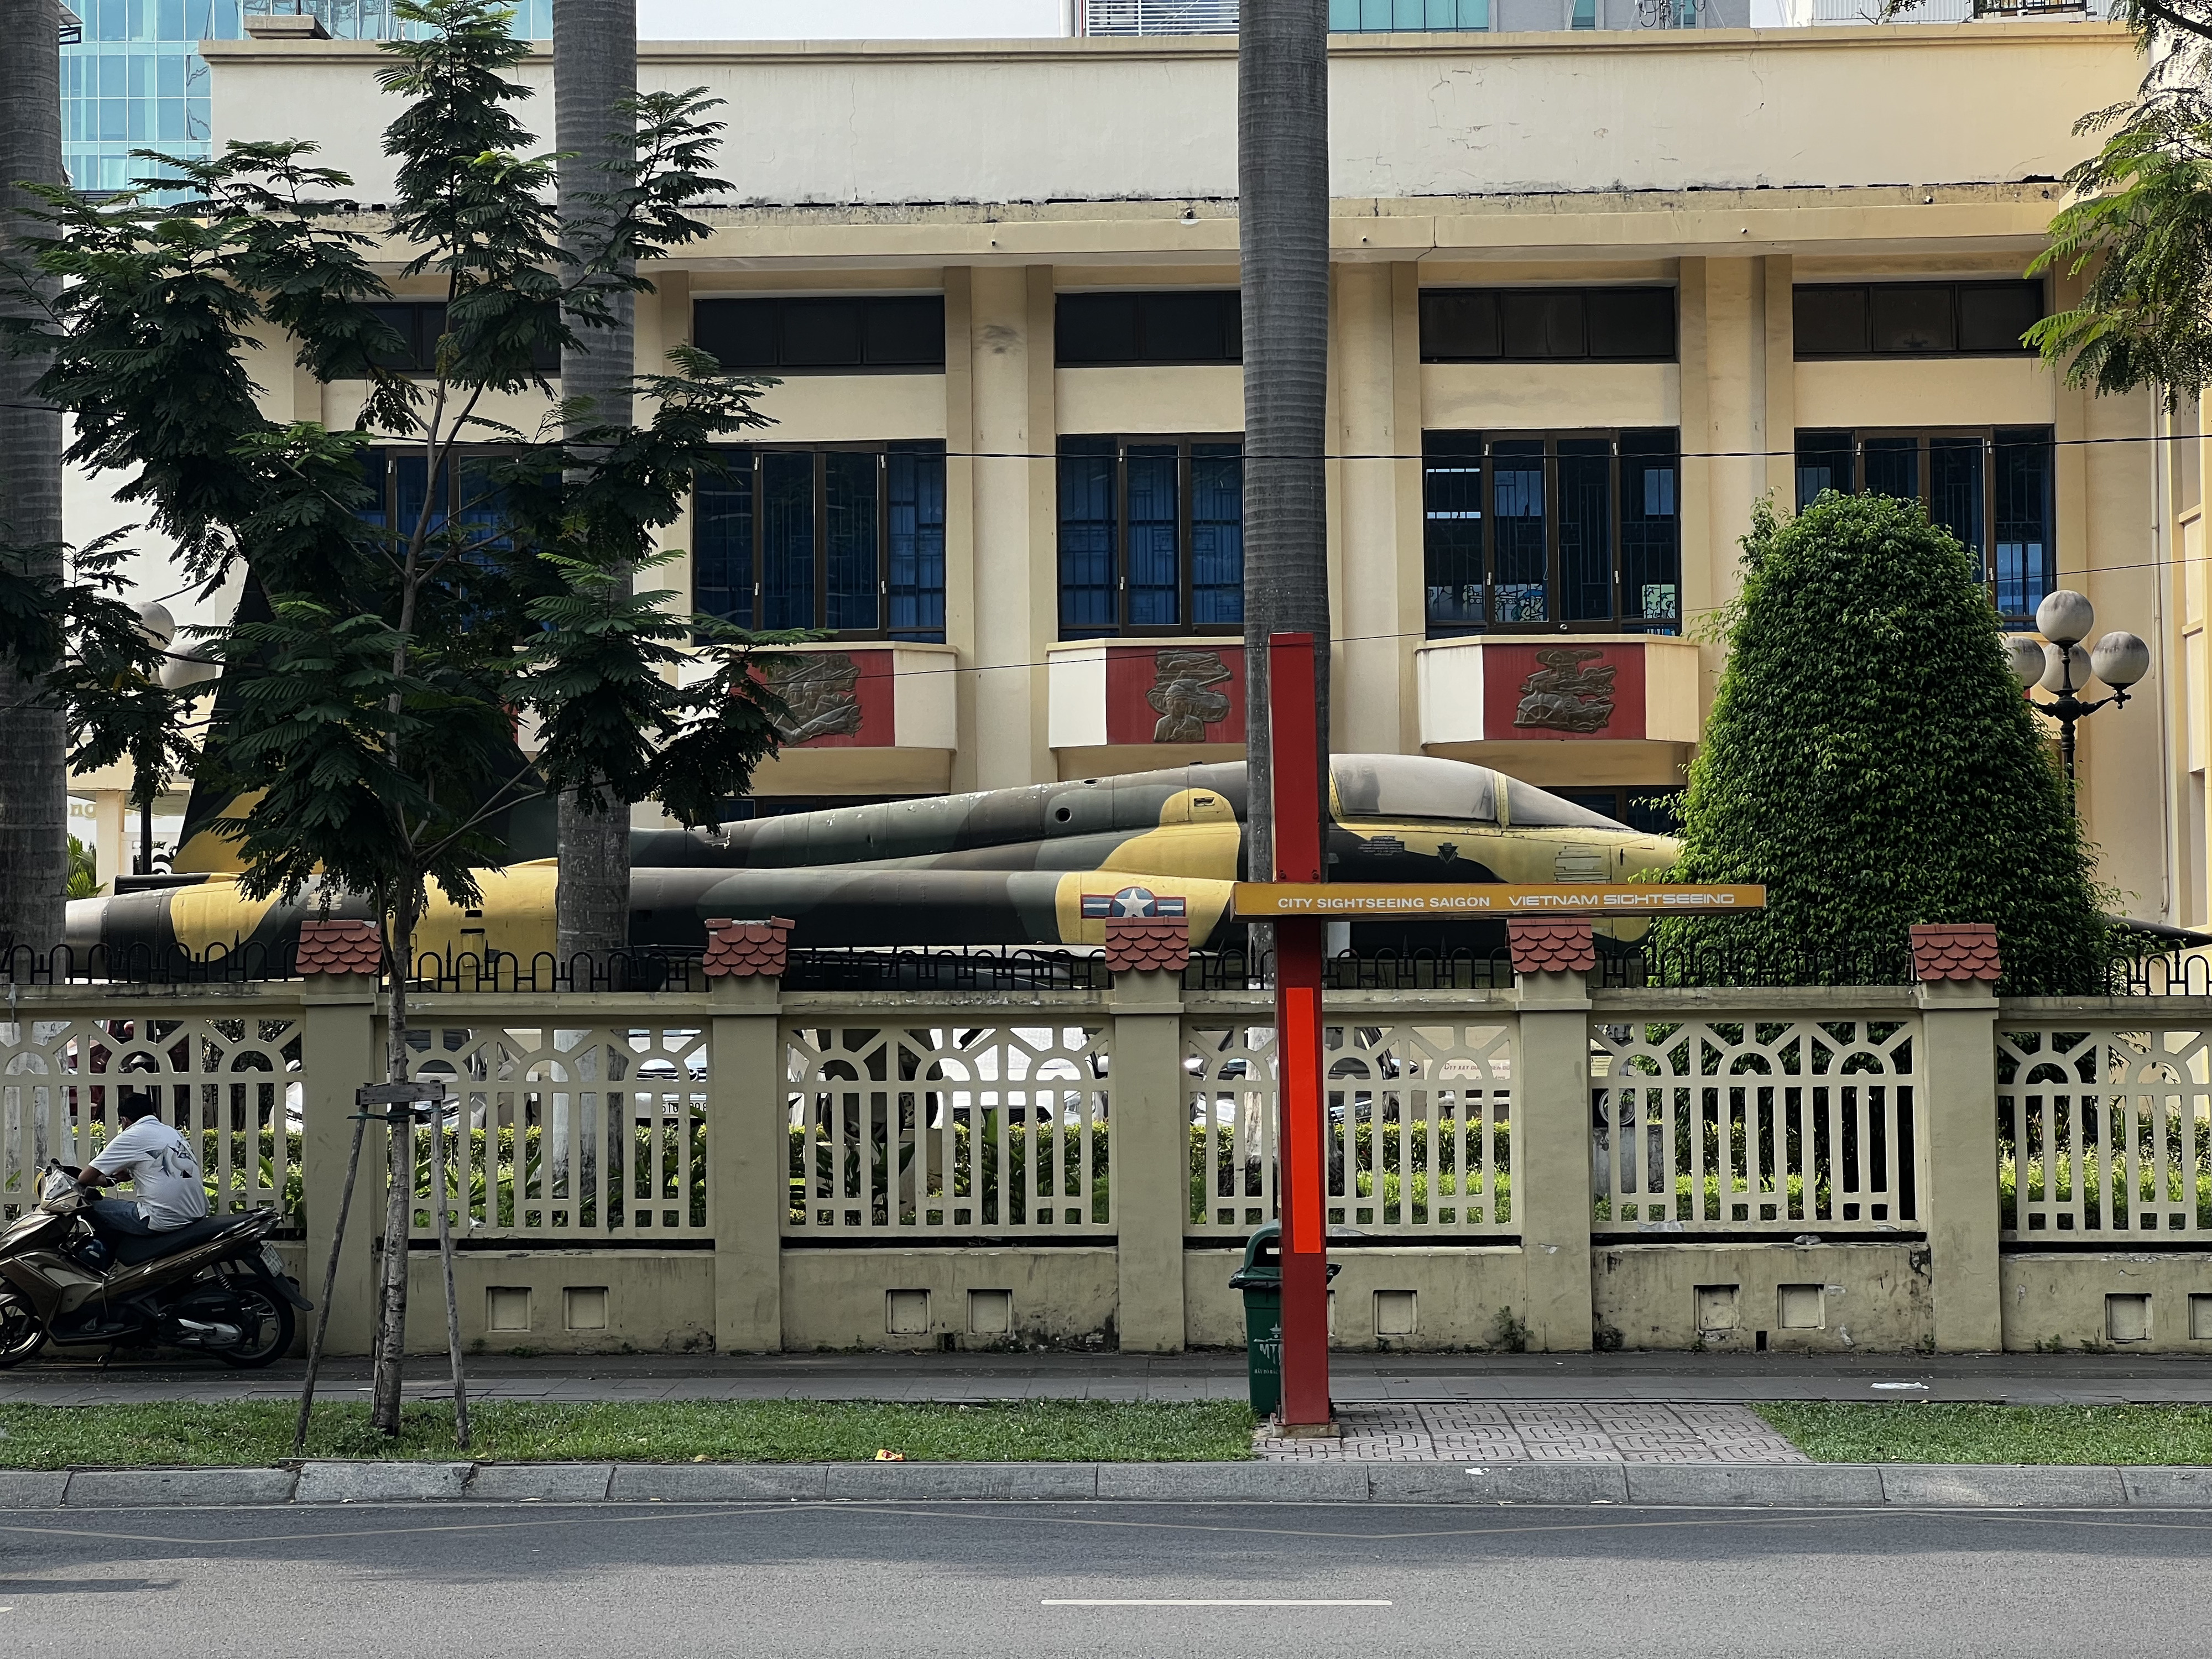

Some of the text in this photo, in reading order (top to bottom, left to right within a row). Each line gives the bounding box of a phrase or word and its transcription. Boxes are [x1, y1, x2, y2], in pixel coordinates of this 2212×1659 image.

[1277, 897, 1490, 908] CITY SIGHTSEEING SAIGON
[1508, 894, 1735, 906] VIETNAM SIGHTSEEING
